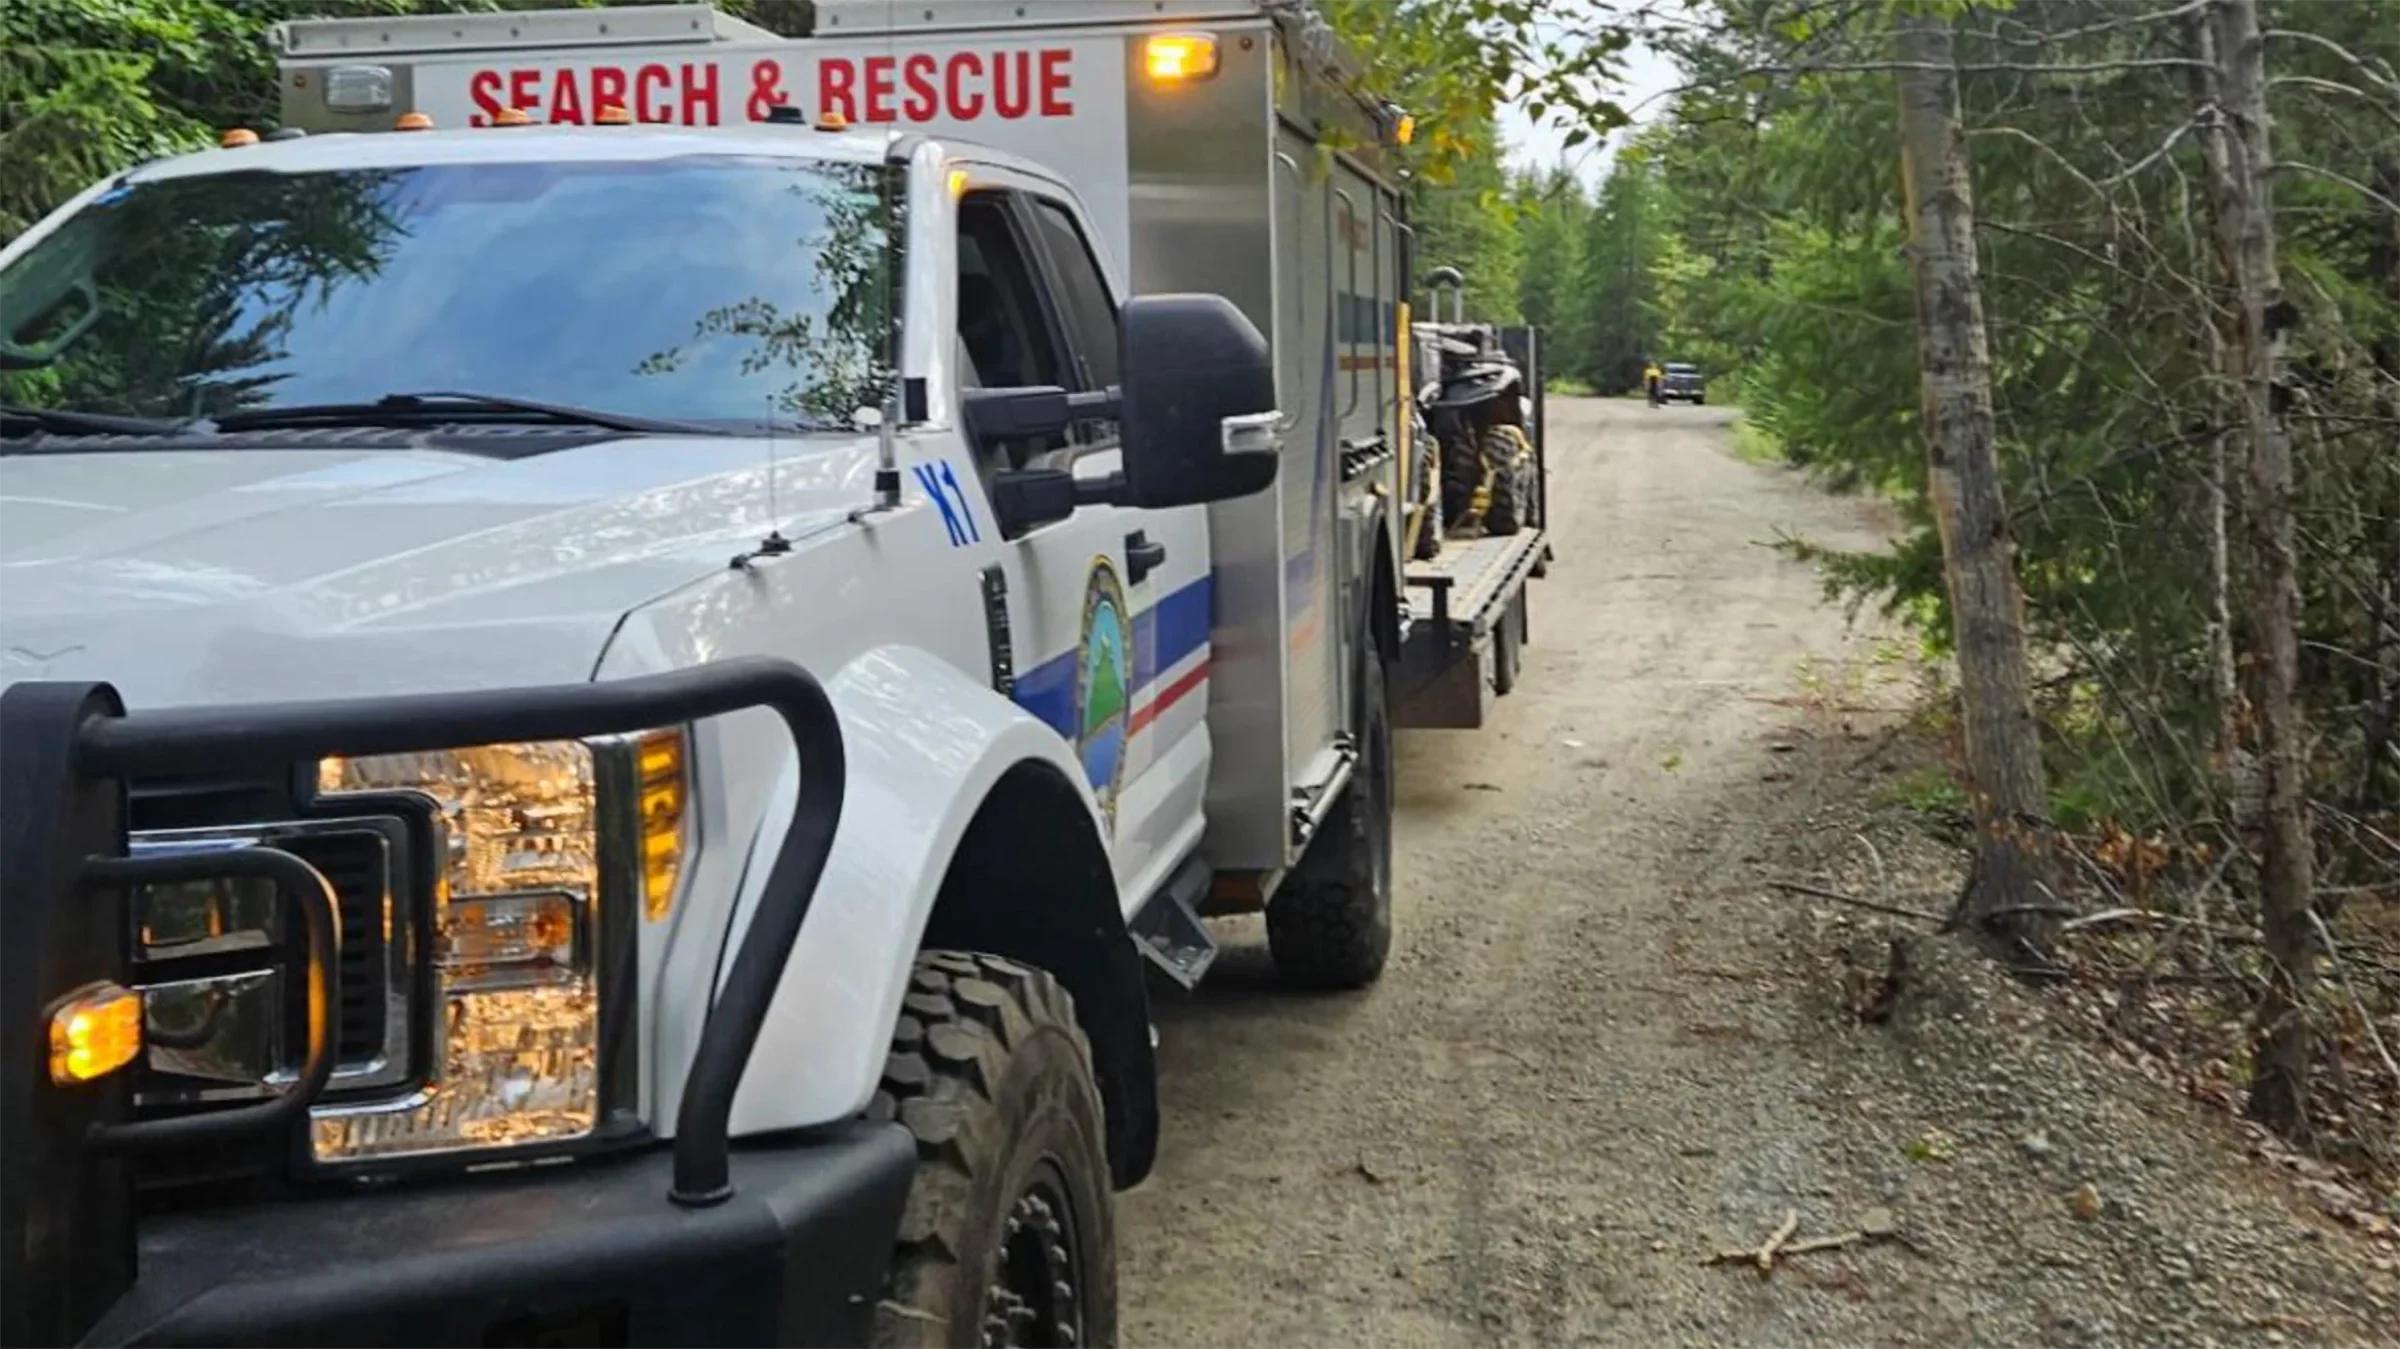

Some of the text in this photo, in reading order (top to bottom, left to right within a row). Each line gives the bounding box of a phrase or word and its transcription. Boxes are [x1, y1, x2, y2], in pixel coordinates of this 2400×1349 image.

[470, 49, 1073, 127] SEARCH & RESCUE
